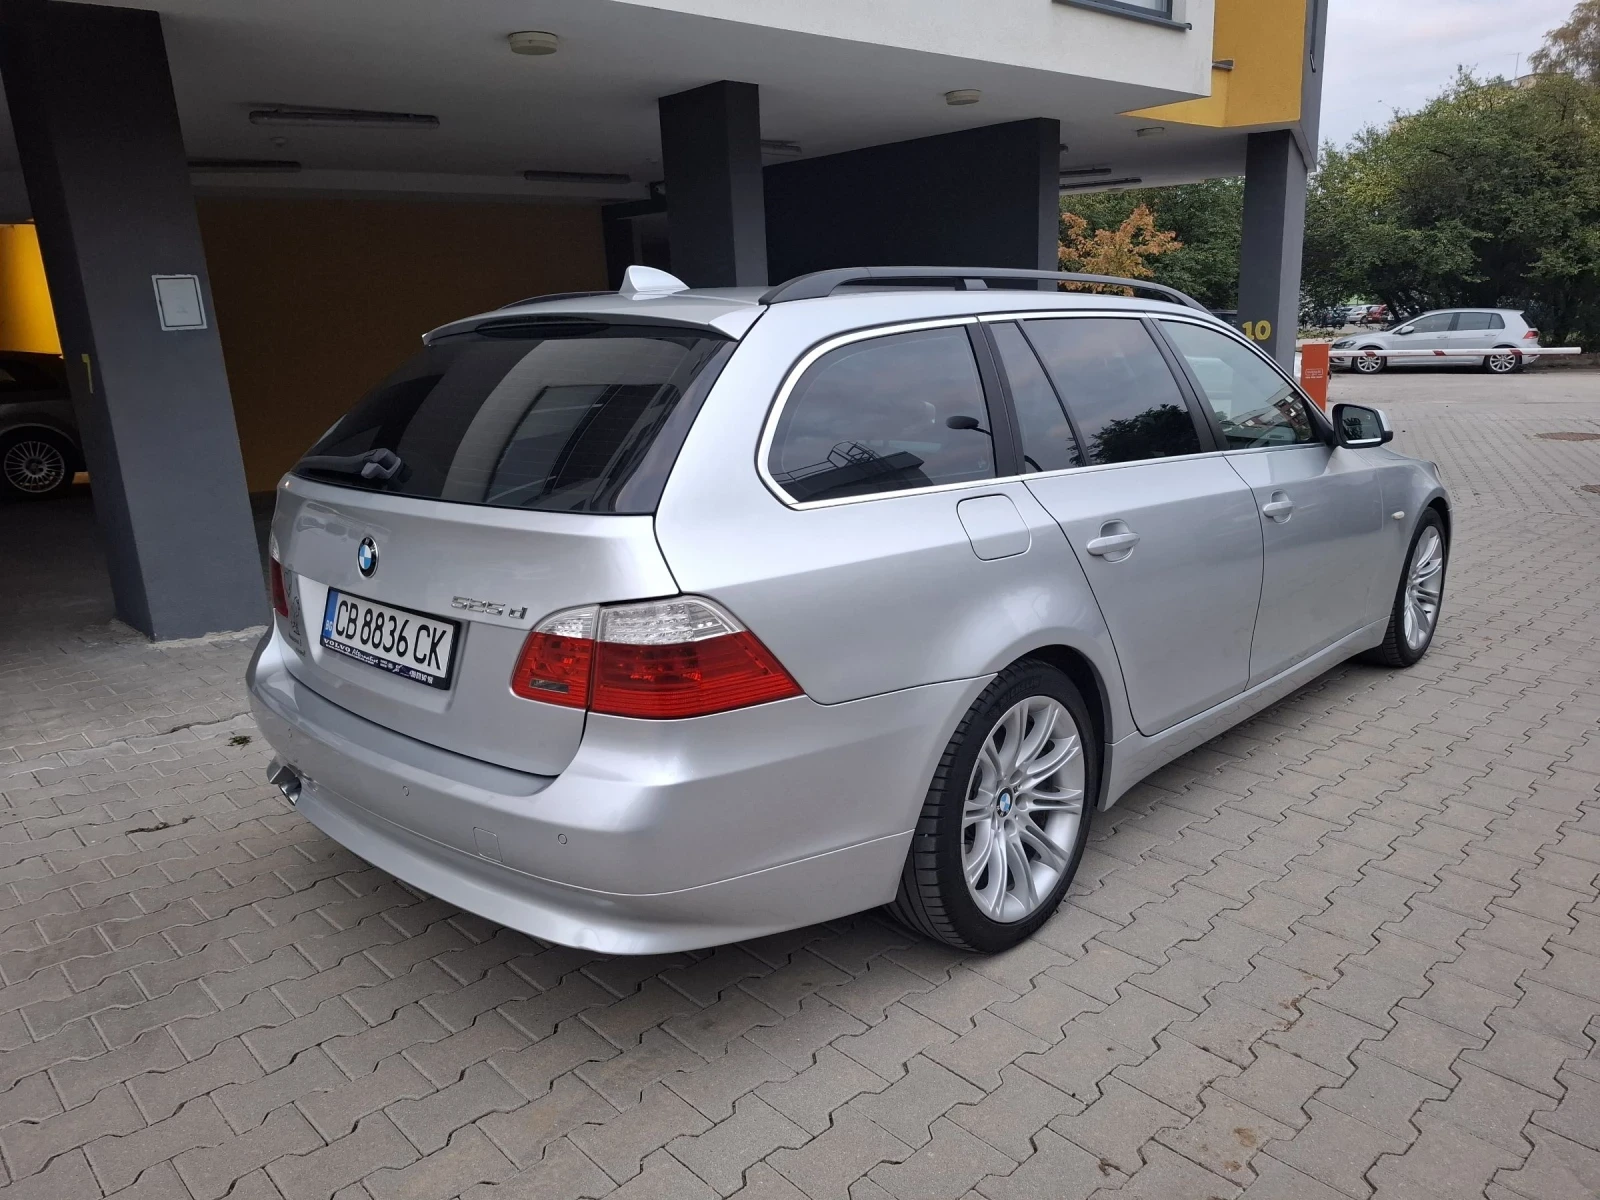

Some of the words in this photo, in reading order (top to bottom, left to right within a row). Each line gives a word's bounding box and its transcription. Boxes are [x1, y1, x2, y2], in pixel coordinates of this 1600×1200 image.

[1242, 320, 1271, 340] 10
[451, 596, 506, 616] 525
[323, 638, 351, 653] VOLVO
[335, 600, 359, 640] CB
[360, 607, 410, 658] 8836
[413, 624, 447, 671] CK
